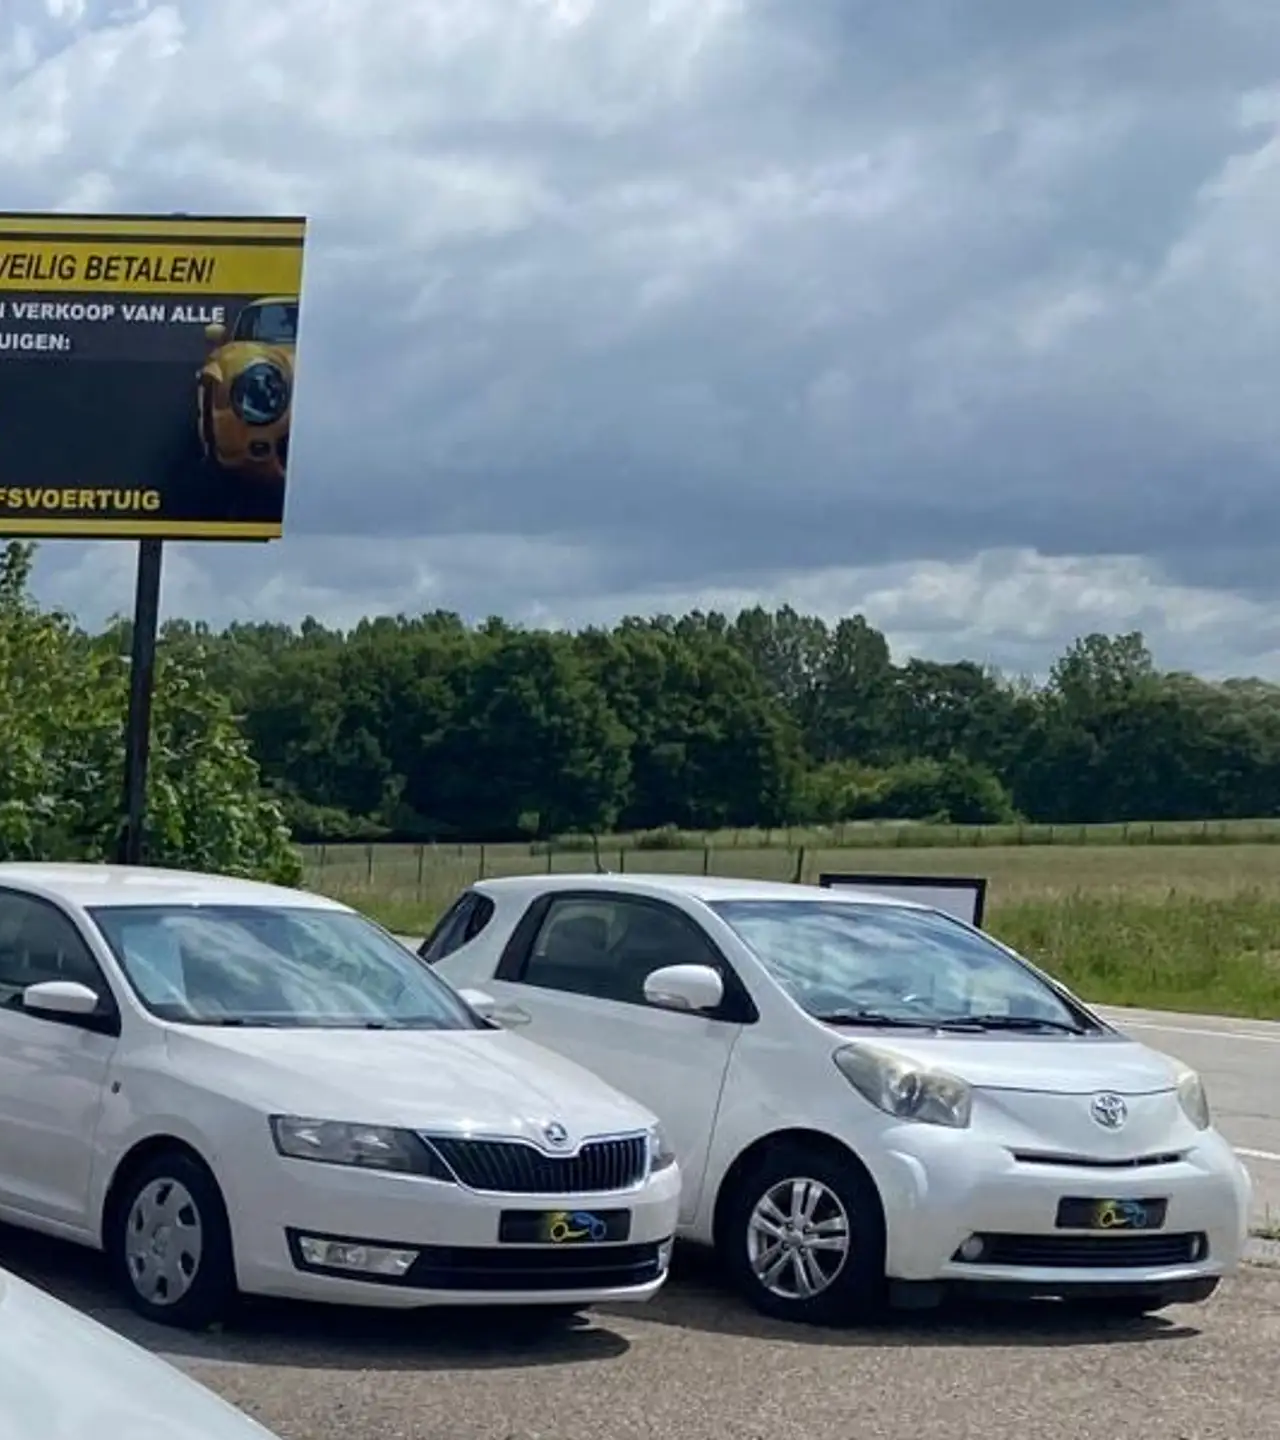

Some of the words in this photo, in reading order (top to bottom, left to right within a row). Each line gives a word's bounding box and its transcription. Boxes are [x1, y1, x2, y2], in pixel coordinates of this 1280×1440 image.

[84, 256, 215, 284] BETALEN!
[12, 303, 115, 321] VERKOOP
[122, 305, 166, 322] VAN
[170, 306, 225, 323] ALLE
